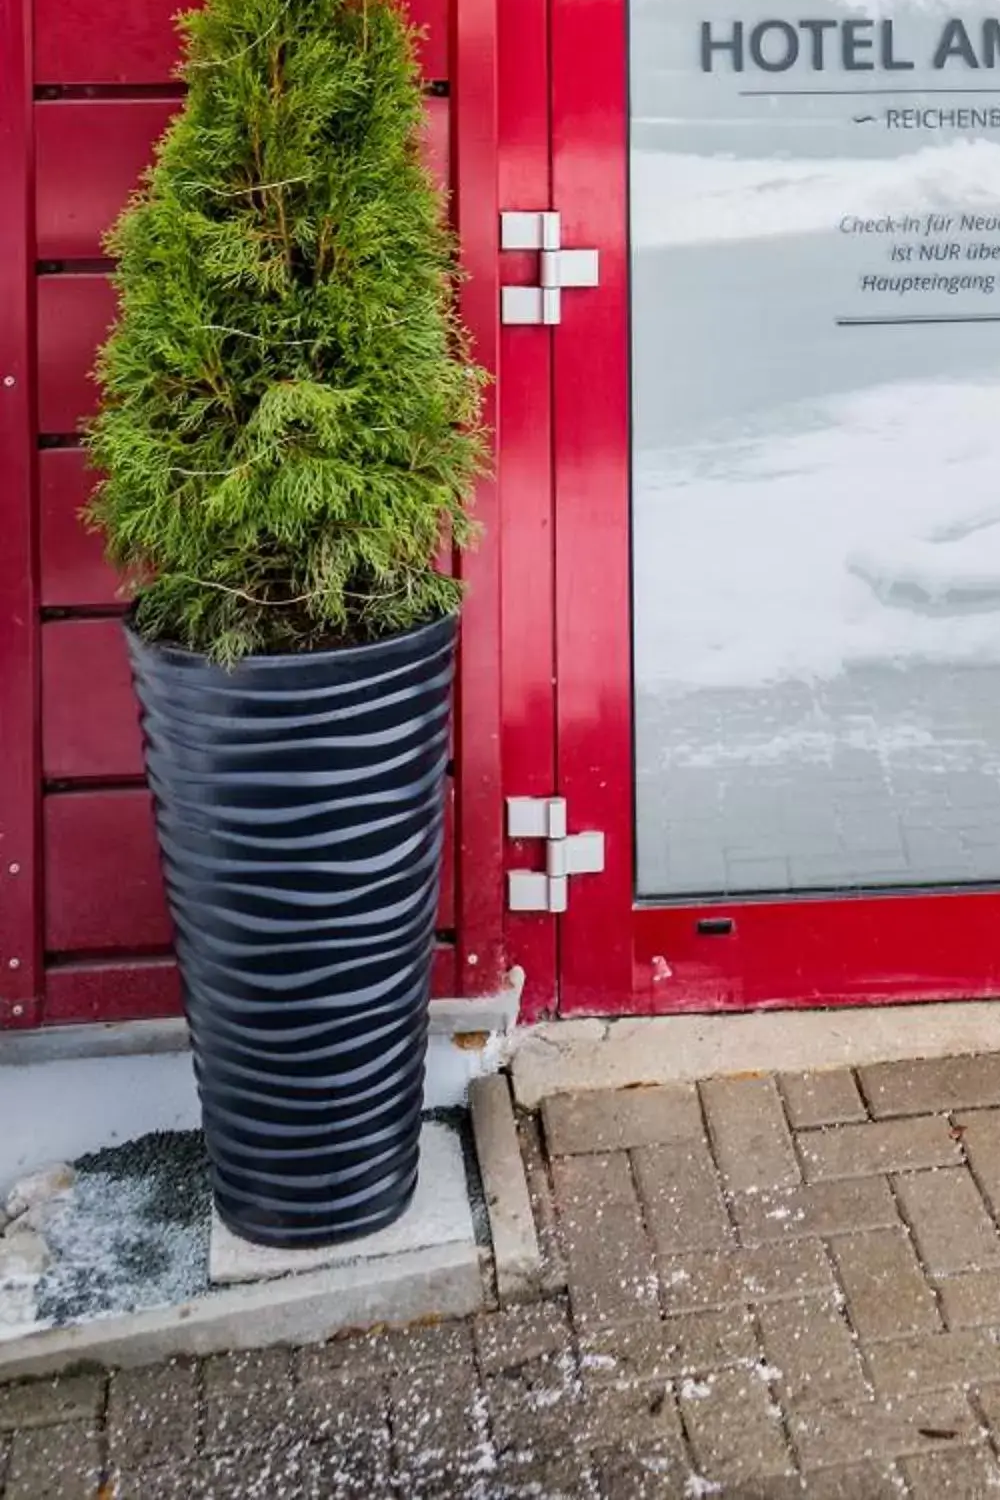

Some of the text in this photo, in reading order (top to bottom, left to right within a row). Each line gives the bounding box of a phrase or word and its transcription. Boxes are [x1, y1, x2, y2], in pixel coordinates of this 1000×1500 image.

[701, 19, 915, 73] HOTEL
[924, 213, 954, 237] für
[919, 243, 961, 261] NUR
[861, 273, 995, 296] Haupteingang
